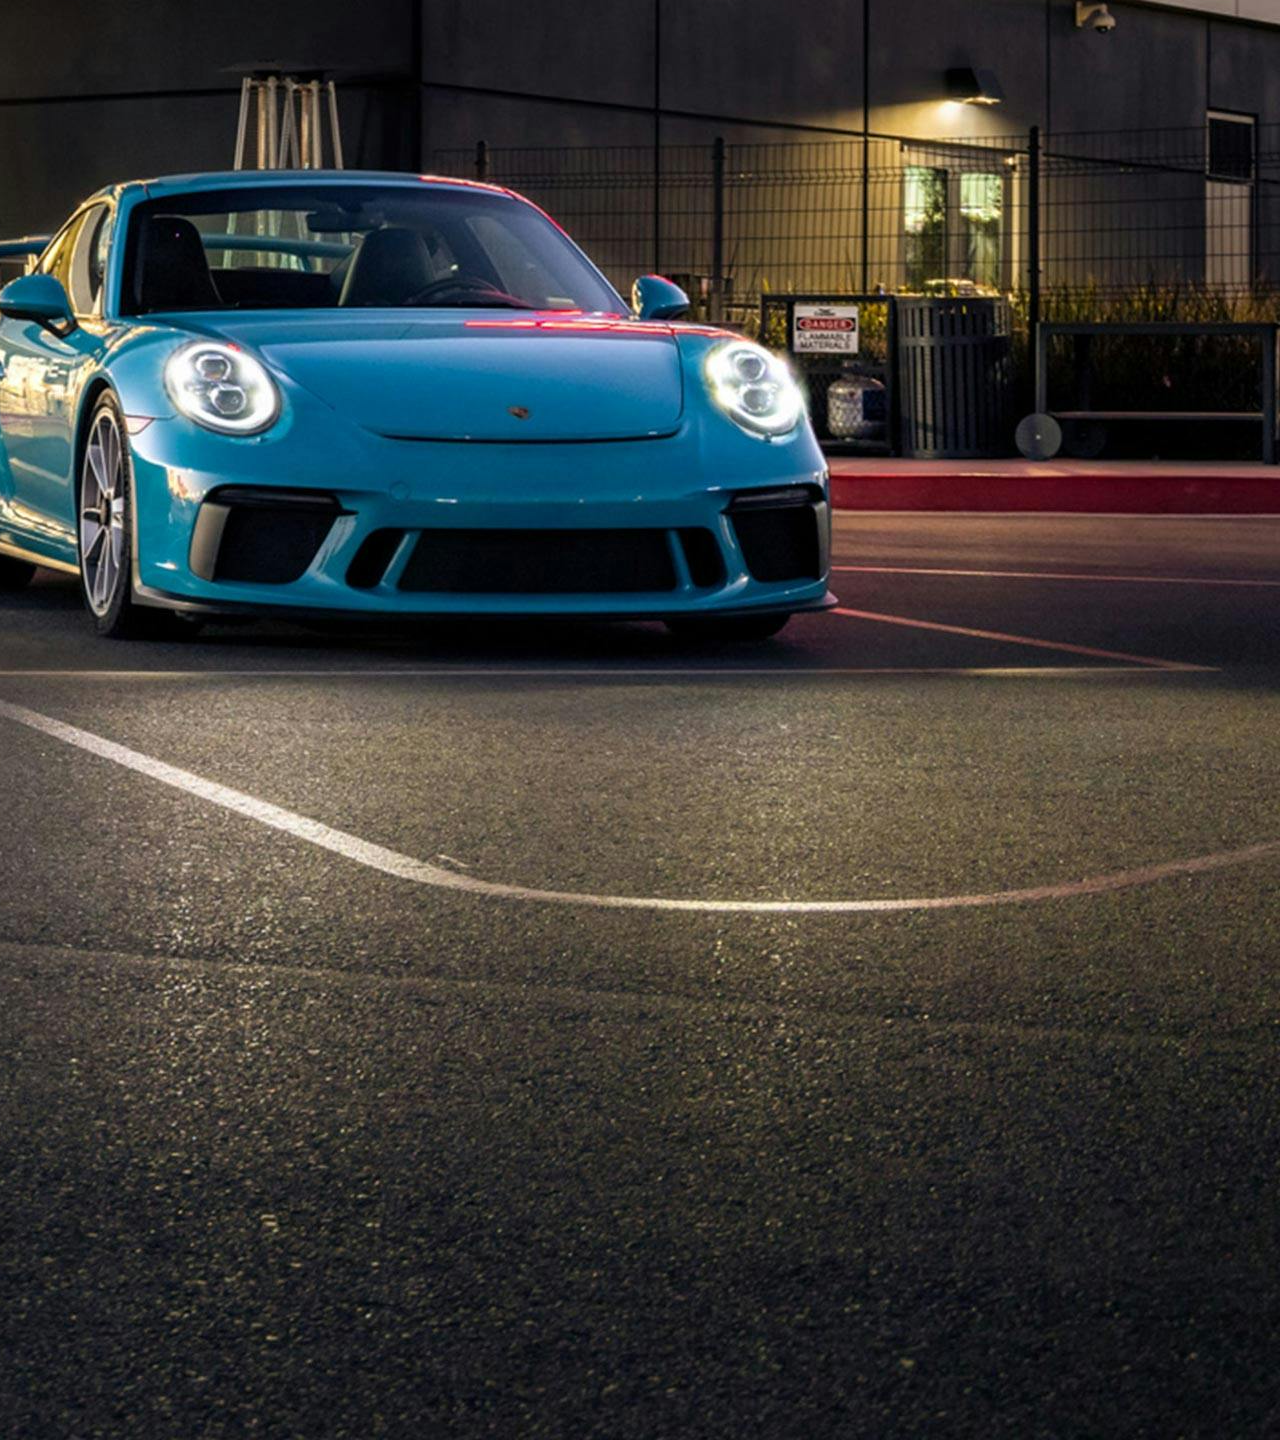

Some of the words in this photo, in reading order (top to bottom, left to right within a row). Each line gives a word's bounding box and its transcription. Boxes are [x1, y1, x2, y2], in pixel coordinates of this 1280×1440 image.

[804, 320, 847, 329] DANGER
[798, 333, 851, 341] FLAMMABLE
[800, 341, 850, 350] MATERIALS
